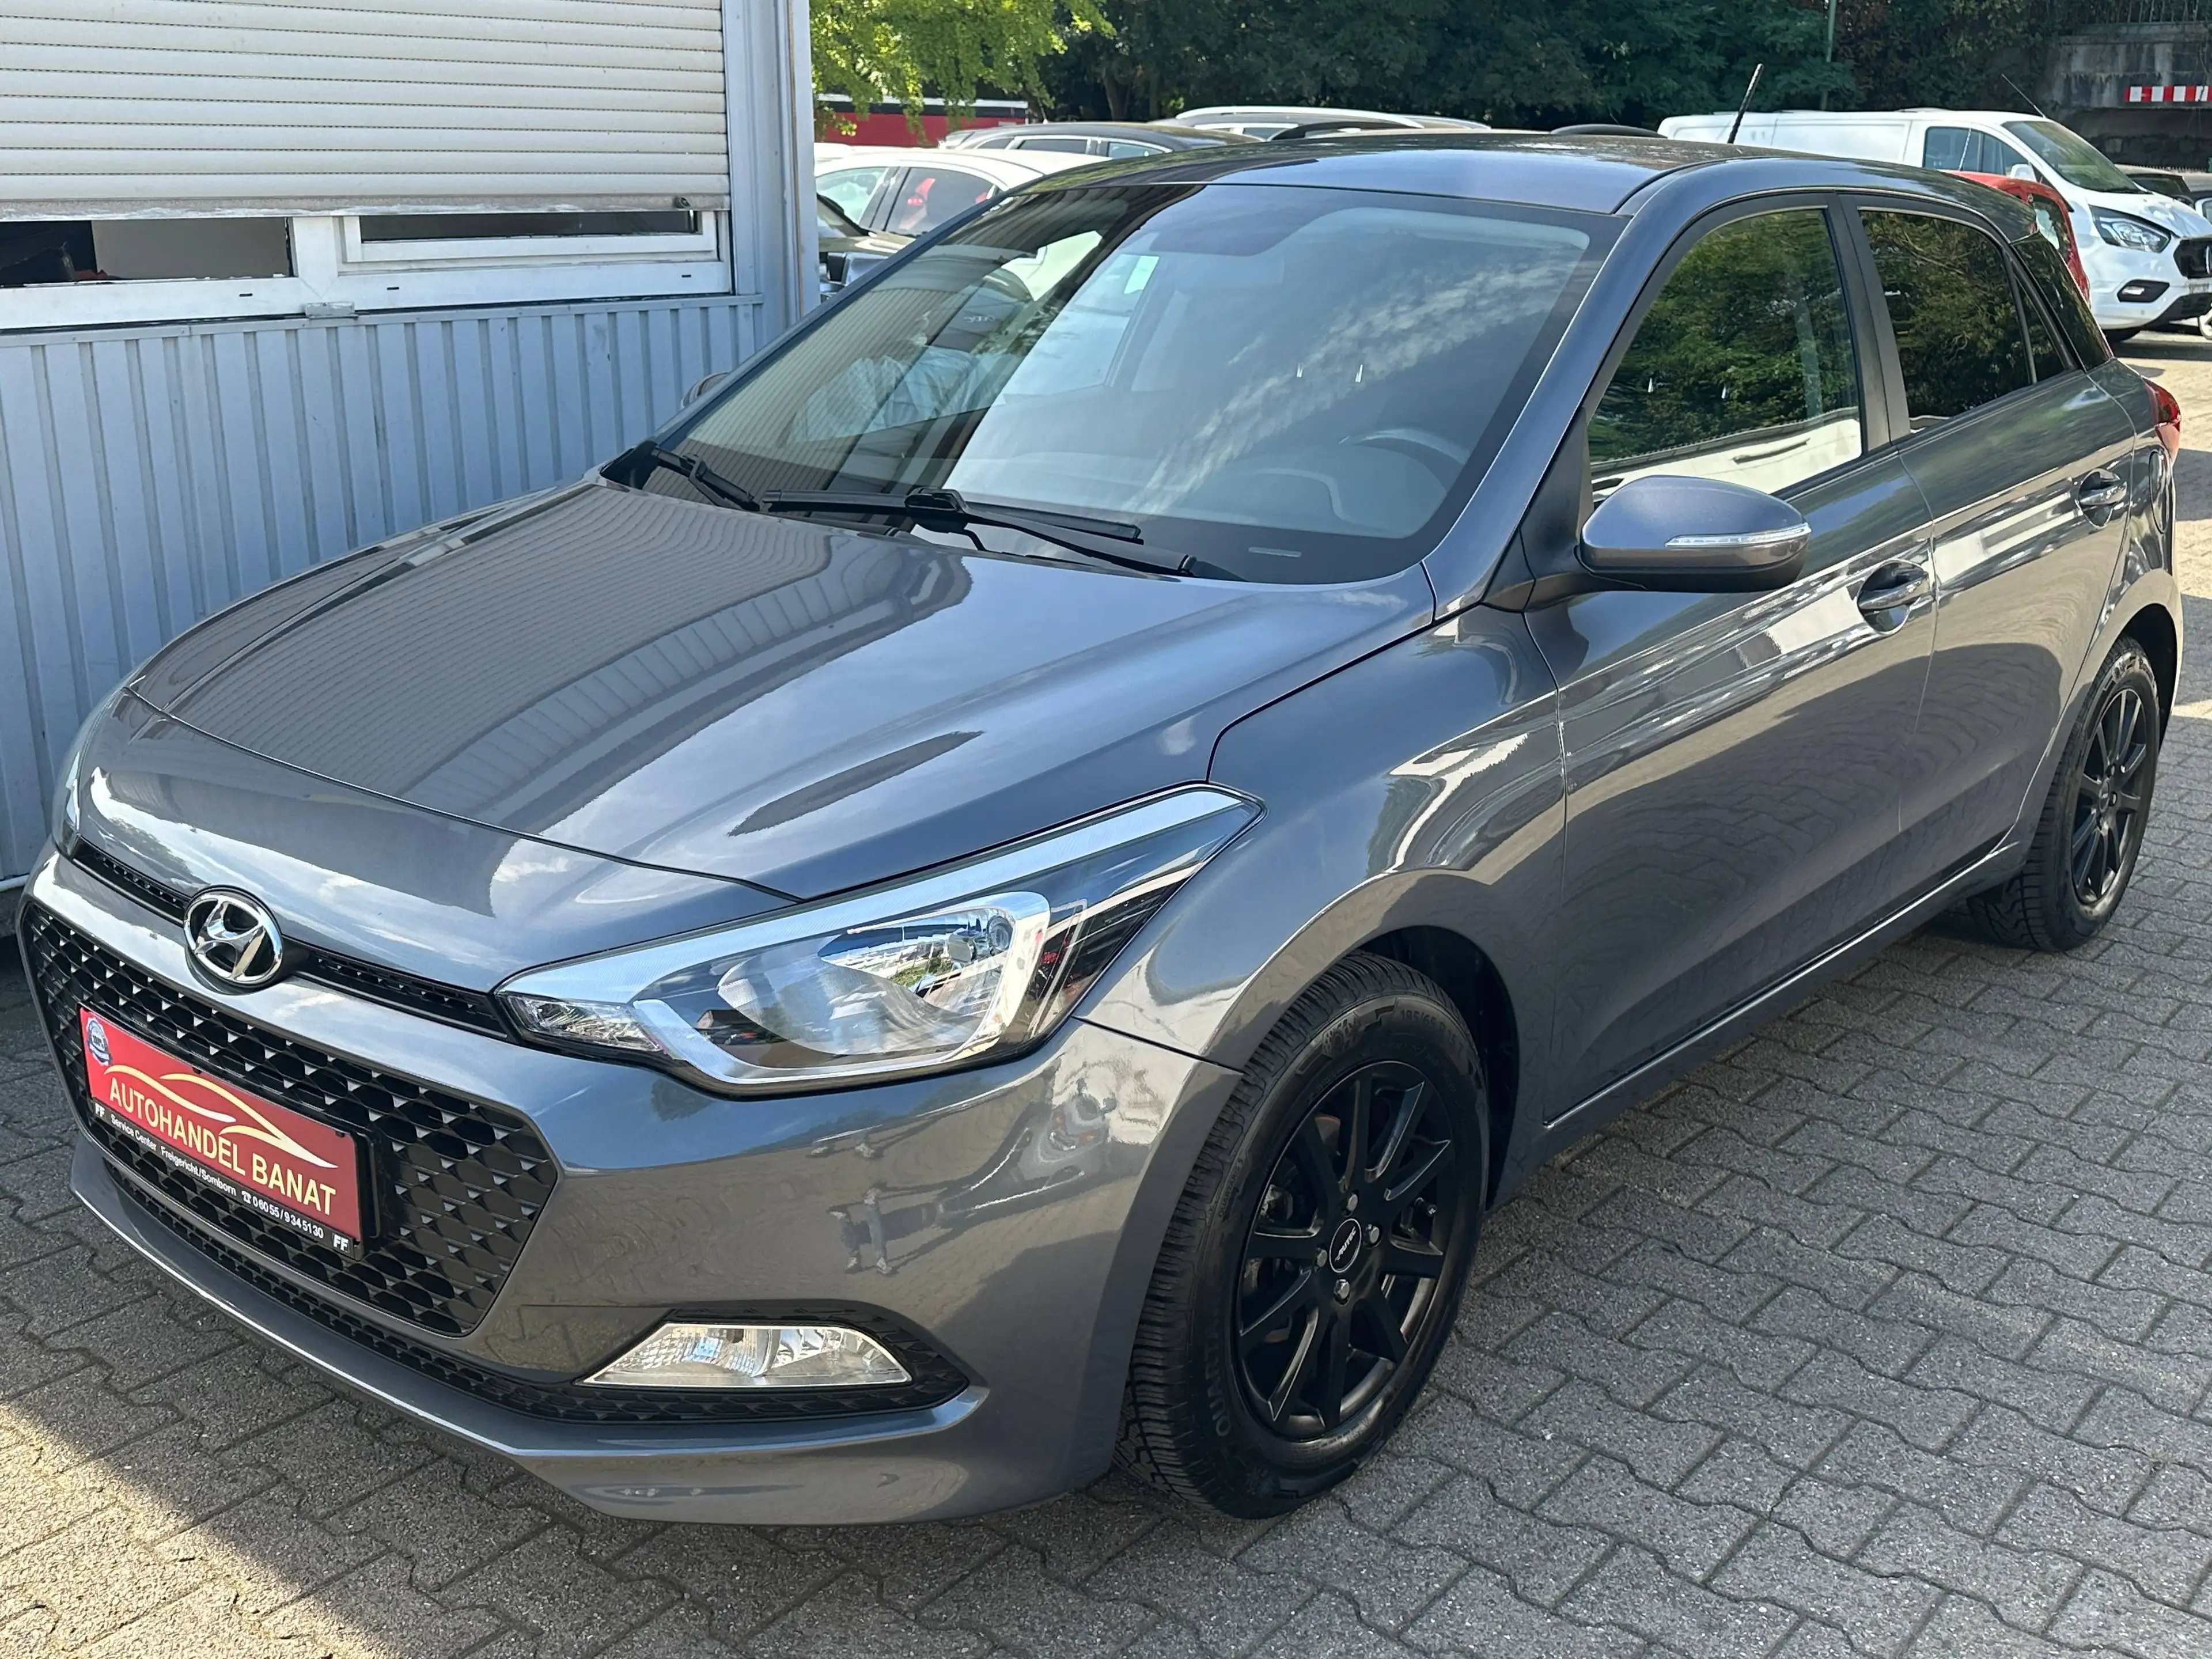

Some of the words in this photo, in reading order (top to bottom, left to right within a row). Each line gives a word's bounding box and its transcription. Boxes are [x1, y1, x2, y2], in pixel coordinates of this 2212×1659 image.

[95, 1103, 105, 1118] FF
[110, 1114, 134, 1137] Service
[135, 1130, 157, 1152] Center
[160, 1145, 237, 1196] Freigericht/Somborn
[332, 1234, 349, 1252] FF
[109, 1076, 246, 1176] AUTOHANDEL
[252, 1152, 336, 1216] BANAT
